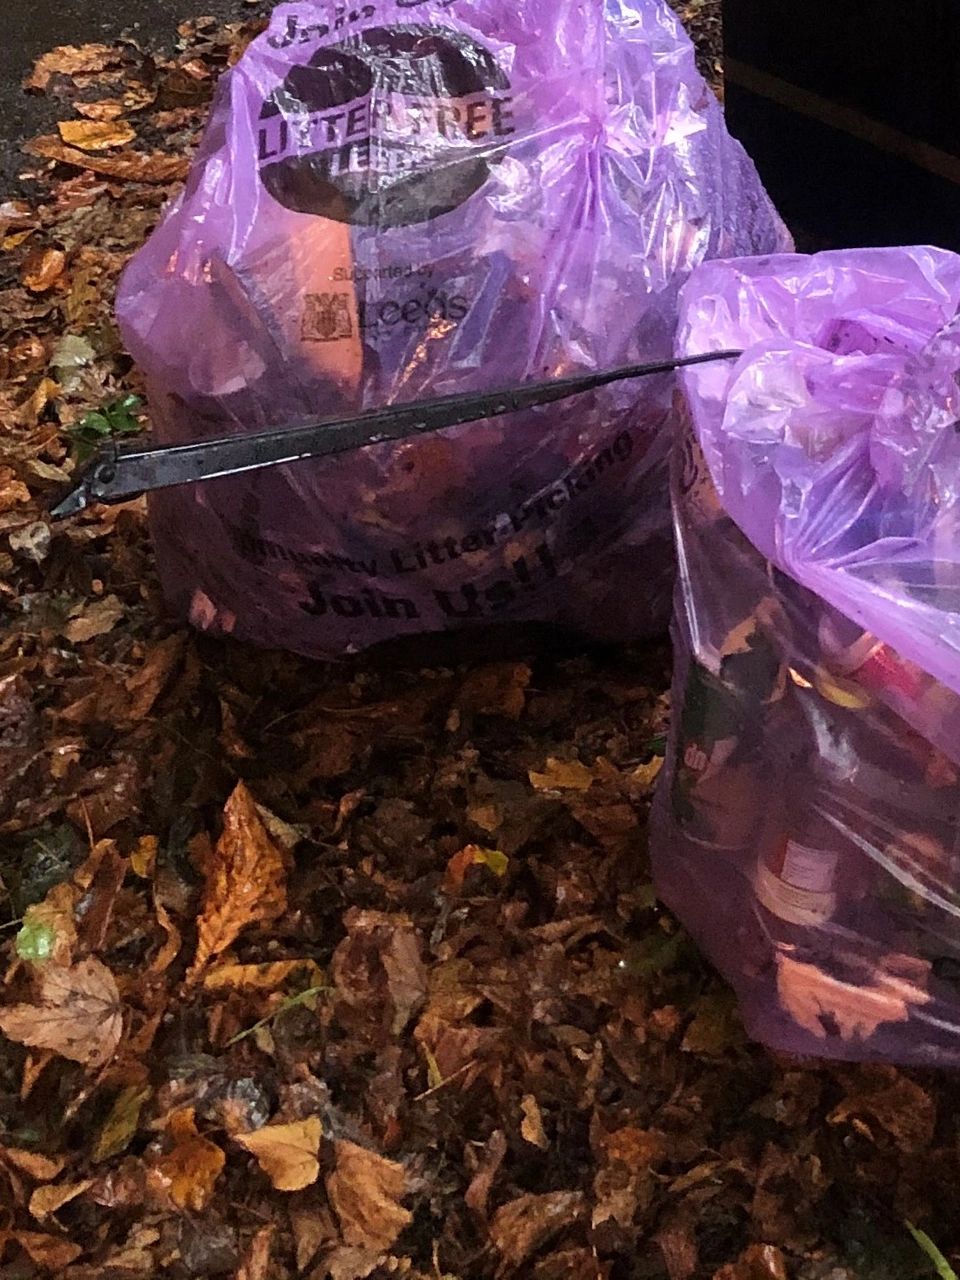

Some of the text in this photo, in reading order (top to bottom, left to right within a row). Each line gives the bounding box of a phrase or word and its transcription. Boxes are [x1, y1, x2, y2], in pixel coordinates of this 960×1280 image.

[299, 541, 557, 619] Join Us!!
[390, 526, 495, 572] Litter
